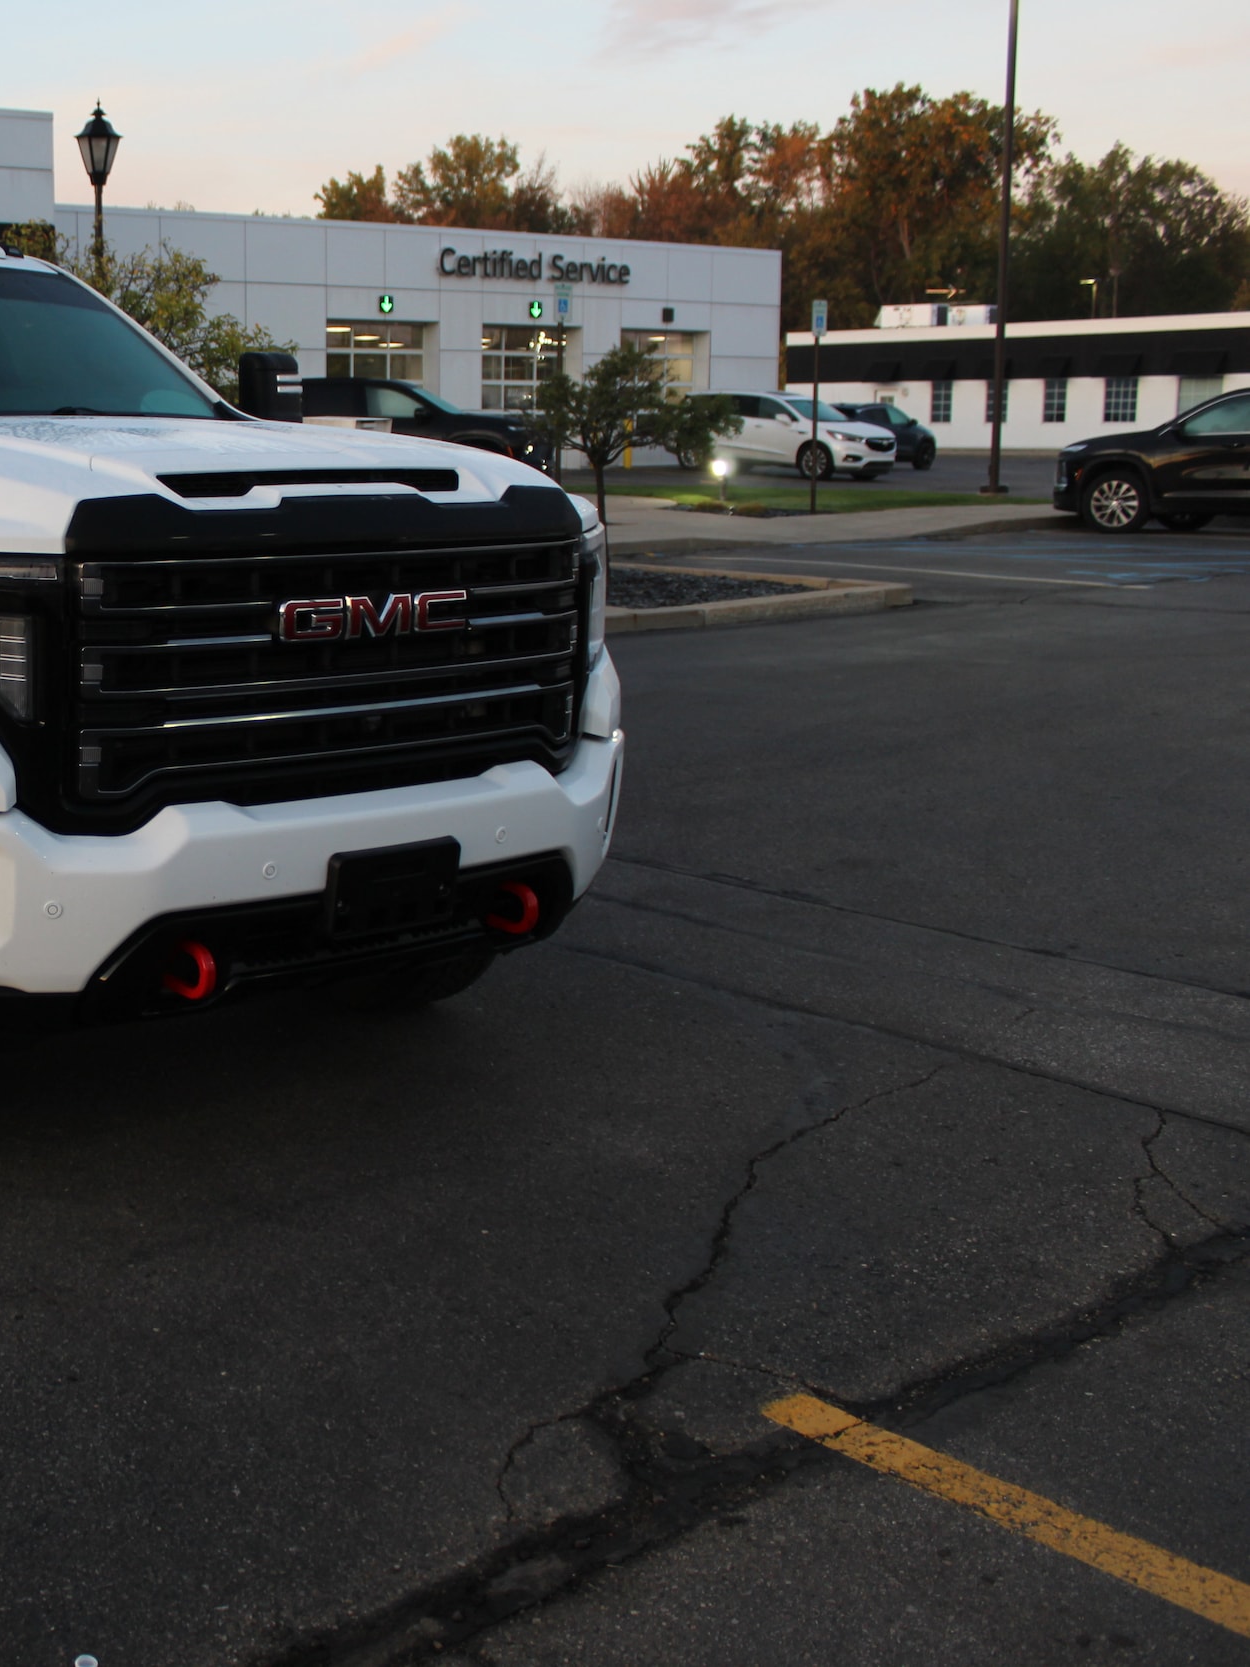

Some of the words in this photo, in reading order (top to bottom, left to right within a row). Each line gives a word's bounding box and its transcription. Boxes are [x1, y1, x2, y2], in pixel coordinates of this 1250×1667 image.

[439, 246, 543, 280] Certified
[550, 253, 631, 284] Service
[279, 589, 468, 642] GMC
